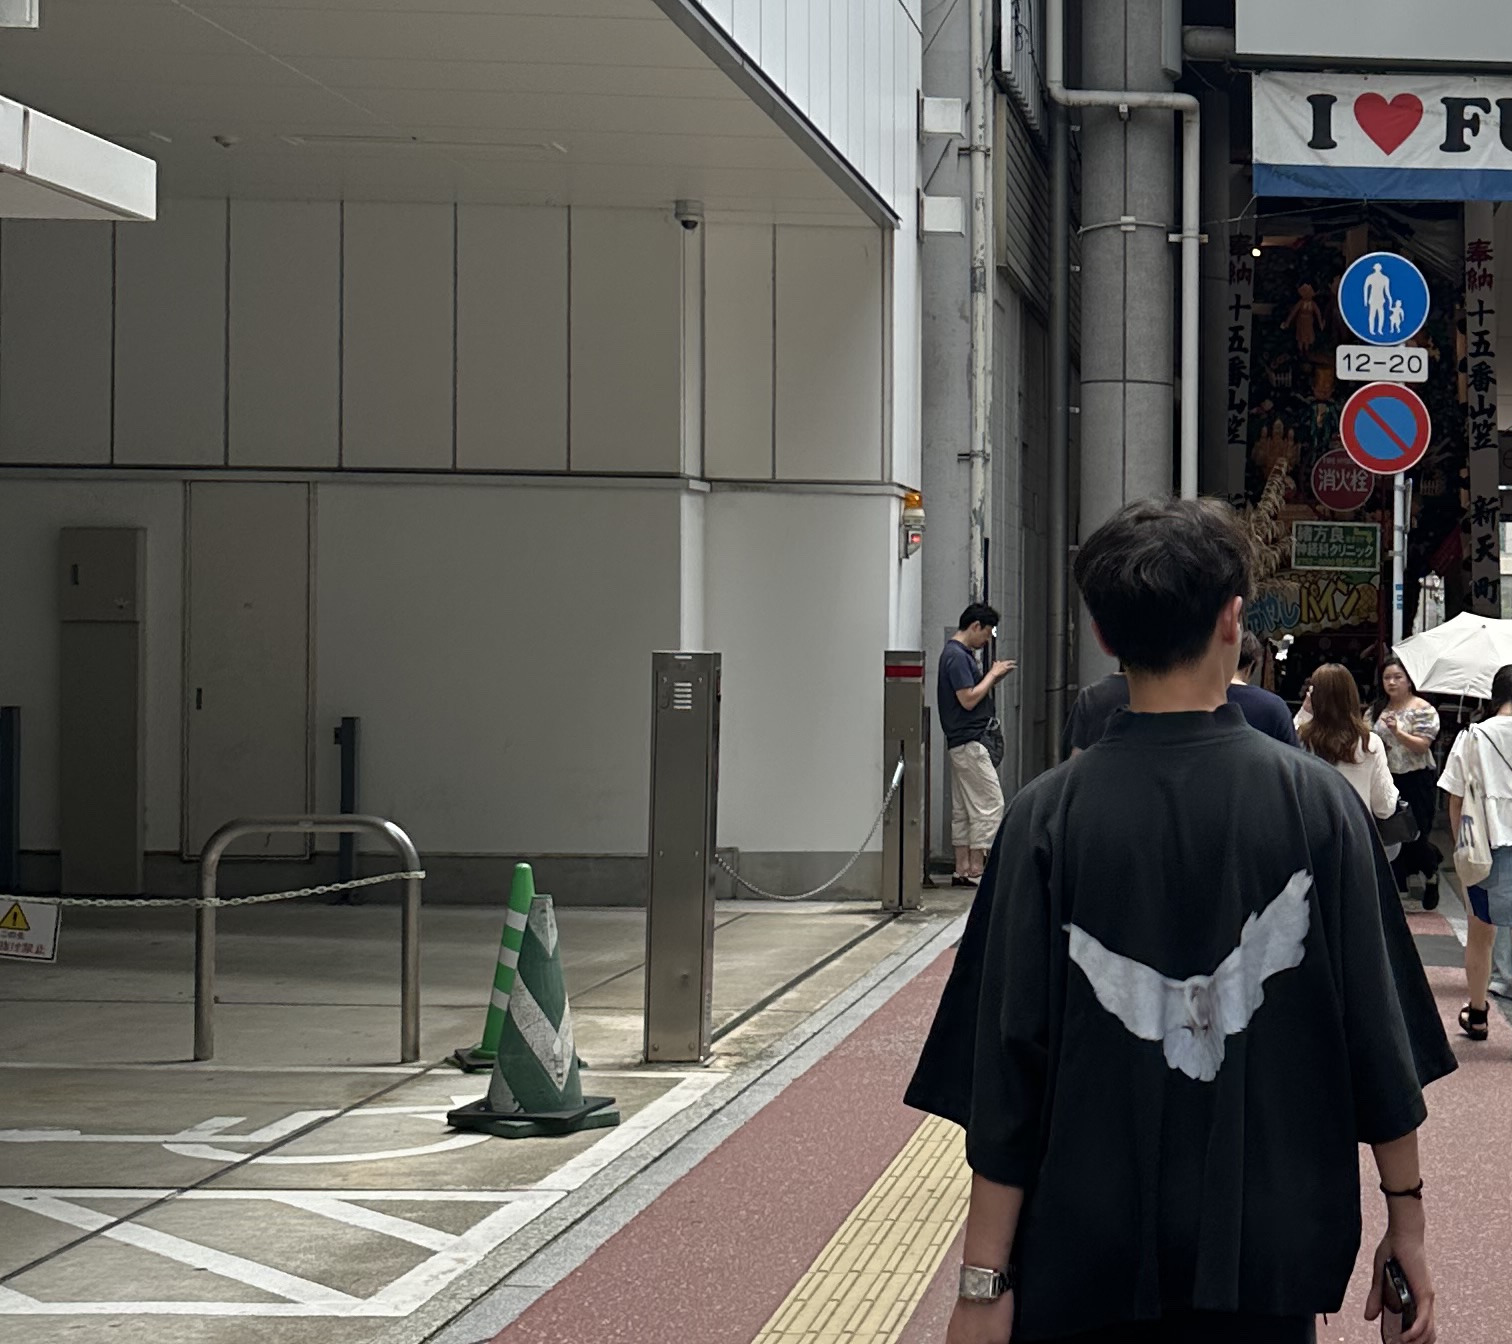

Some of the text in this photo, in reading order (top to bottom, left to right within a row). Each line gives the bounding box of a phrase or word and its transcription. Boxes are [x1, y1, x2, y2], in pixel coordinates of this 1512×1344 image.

[1306, 93, 1337, 150] I
[1341, 353, 1423, 374] 12-20
[1467, 299, 1498, 451] 十五番山笠
[1318, 468, 1368, 492] 消火栓
[1296, 542, 1374, 558] 神経科クリニック
[1471, 495, 1500, 605] 新天町
